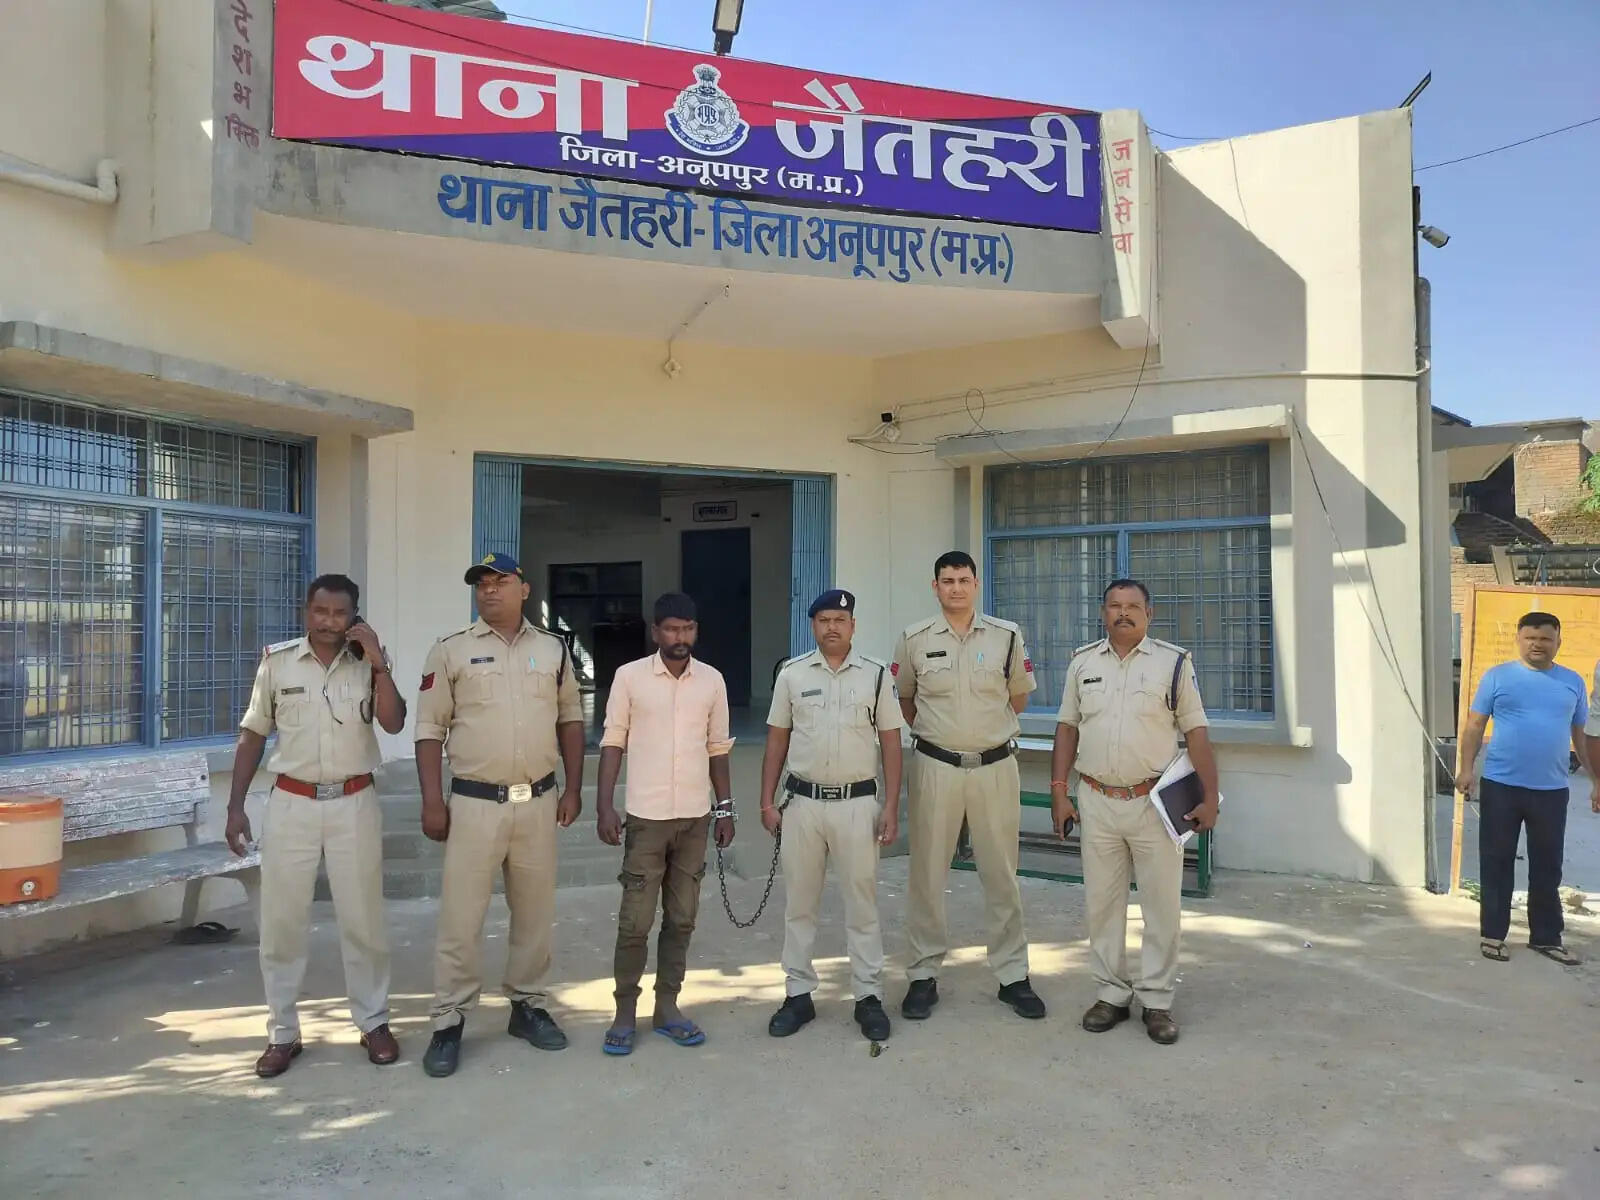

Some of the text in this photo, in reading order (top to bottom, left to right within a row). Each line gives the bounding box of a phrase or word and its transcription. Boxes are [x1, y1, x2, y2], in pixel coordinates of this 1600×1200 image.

[298, 35, 1091, 197] थाना जैतहरी
[437, 174, 553, 231] थाना
[803, 217, 926, 282] अनूपपुर
